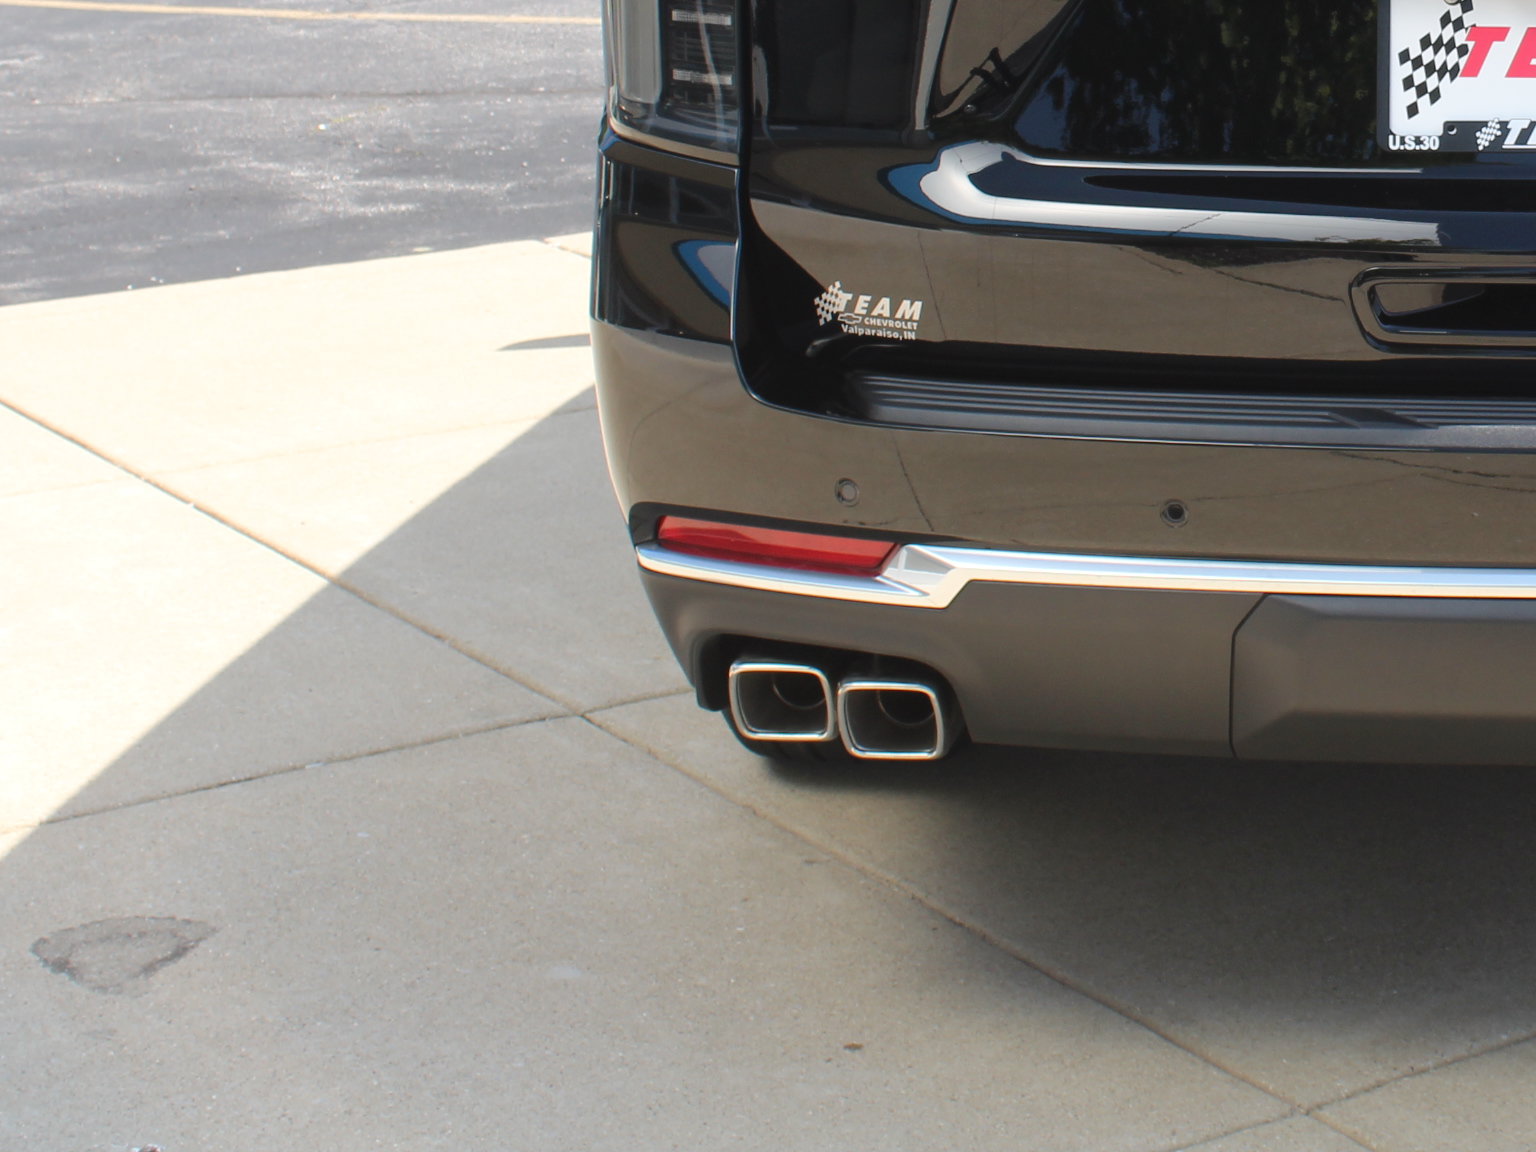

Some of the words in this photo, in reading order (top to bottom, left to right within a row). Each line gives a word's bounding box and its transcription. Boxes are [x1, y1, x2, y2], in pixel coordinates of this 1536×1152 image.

[1387, 134, 1441, 152] U.S.30
[836, 291, 923, 321] TEAM
[863, 317, 919, 330] CHEVROLET
